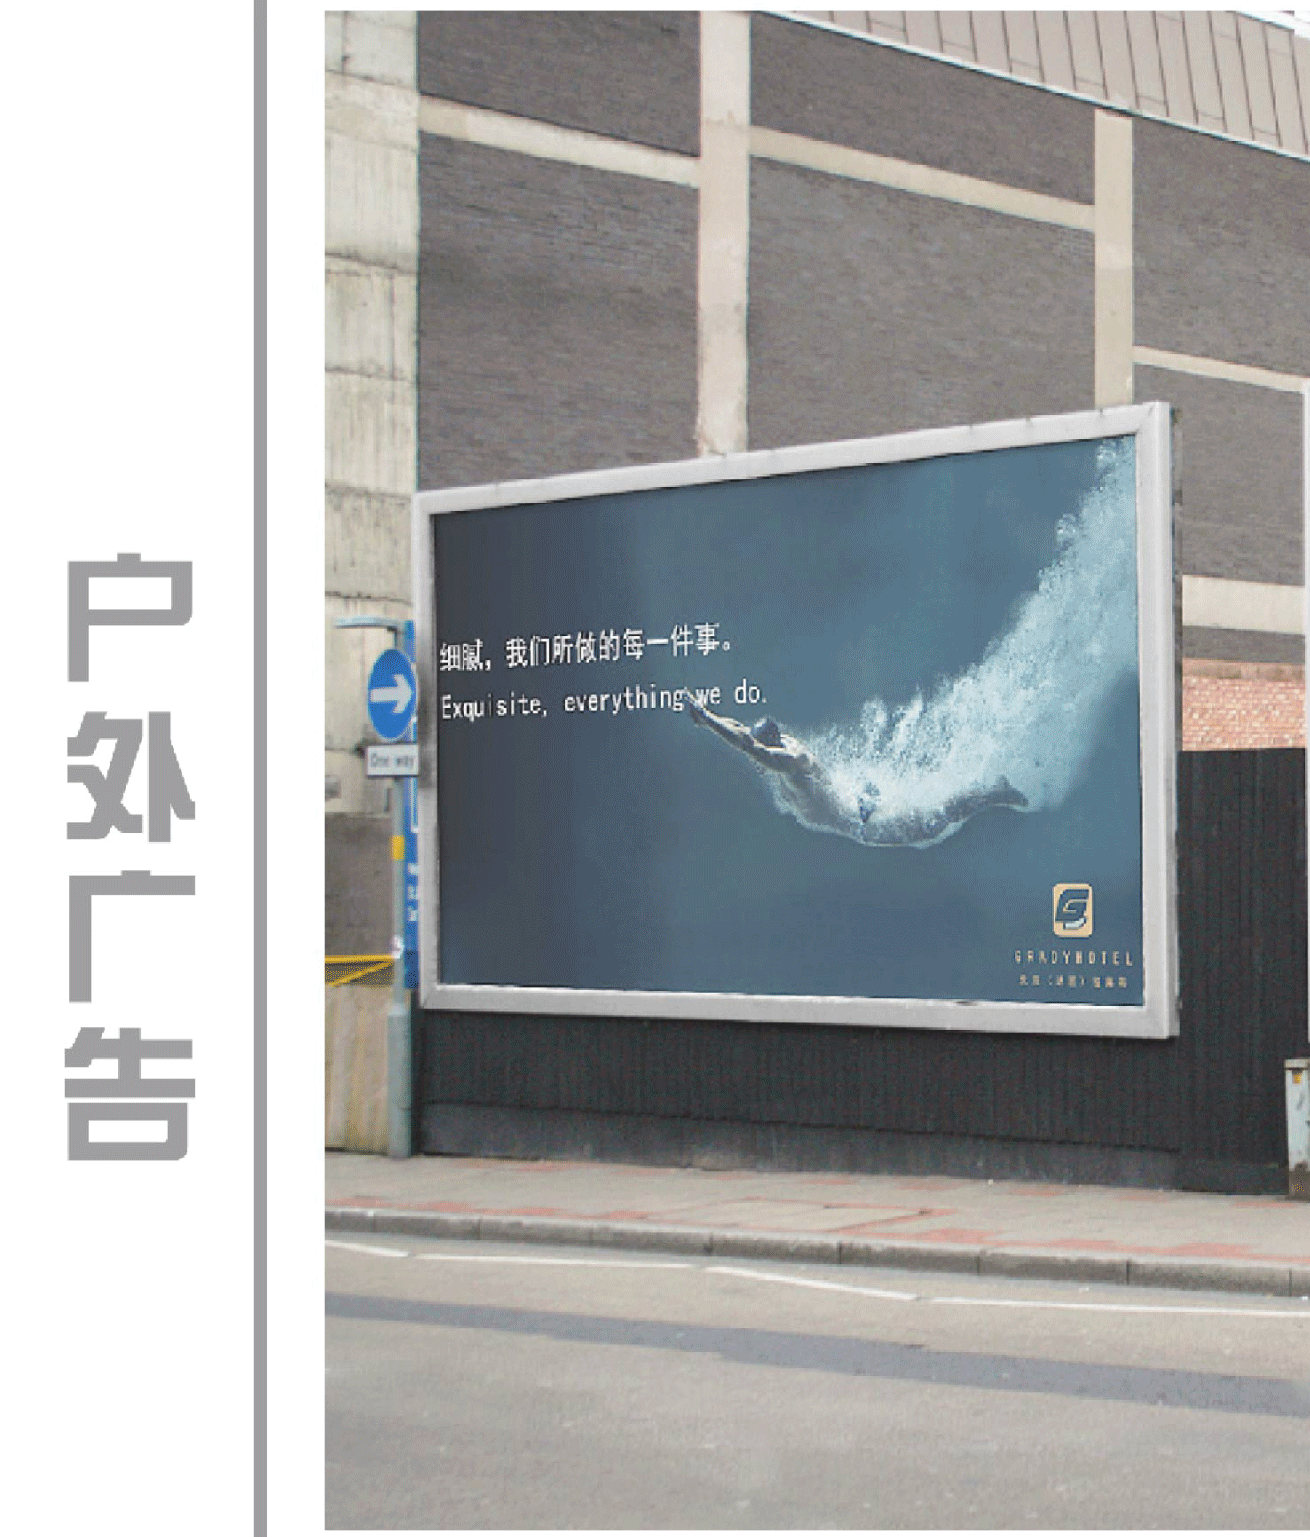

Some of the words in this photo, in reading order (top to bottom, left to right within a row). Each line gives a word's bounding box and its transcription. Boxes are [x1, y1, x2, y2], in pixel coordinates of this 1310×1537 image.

[441, 690, 548, 723] Exquisite,
[564, 683, 686, 716] everything
[695, 686, 722, 705] we
[734, 678, 768, 704] do.
